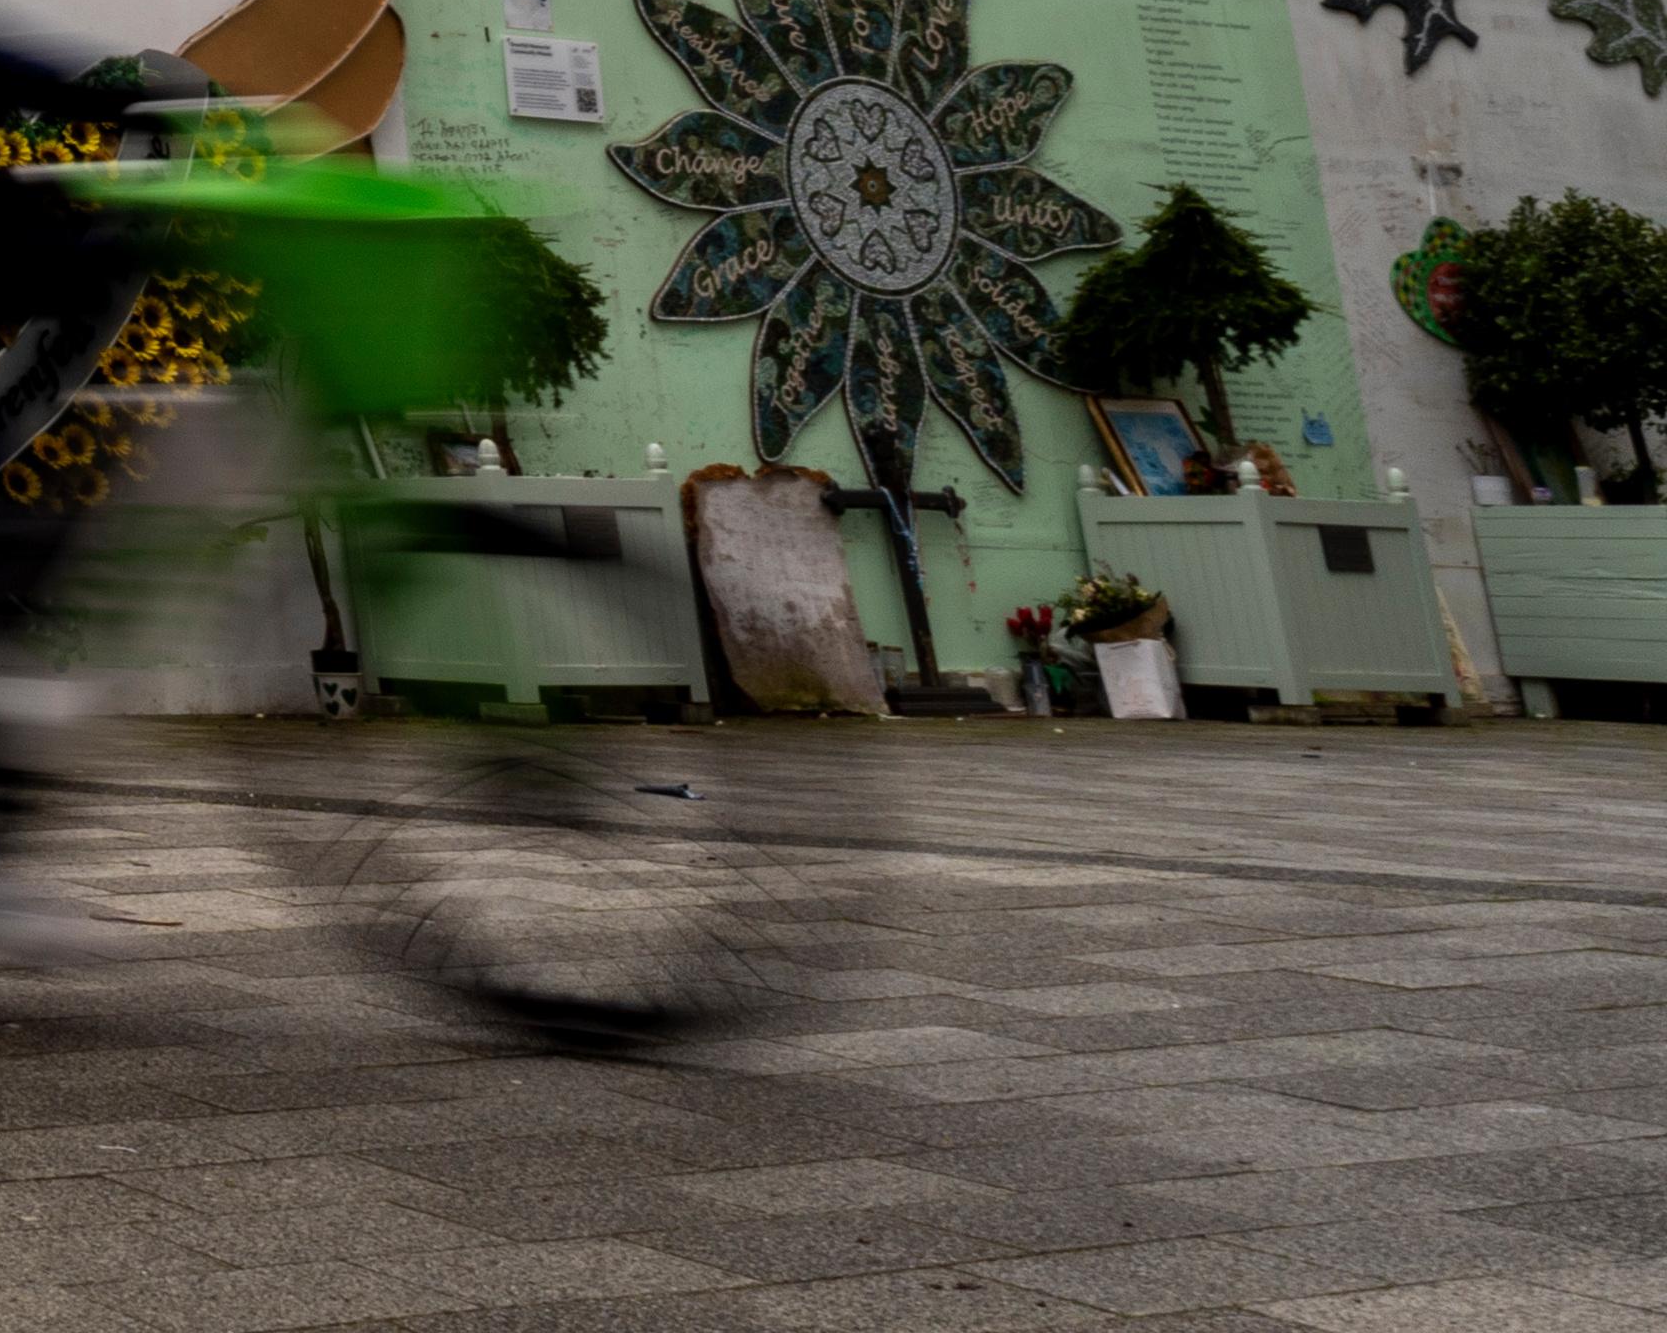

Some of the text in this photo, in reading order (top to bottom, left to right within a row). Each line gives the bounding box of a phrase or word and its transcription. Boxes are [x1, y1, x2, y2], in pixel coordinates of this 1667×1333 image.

[668, 7, 772, 104] Resilience
[966, 89, 1032, 139] Hope
[654, 144, 766, 183] Change
[991, 194, 1075, 237] Unity
[692, 236, 773, 299] Grace
[968, 262, 1049, 339] Solidar
[771, 301, 827, 419] Together
[877, 332, 900, 434] urage
